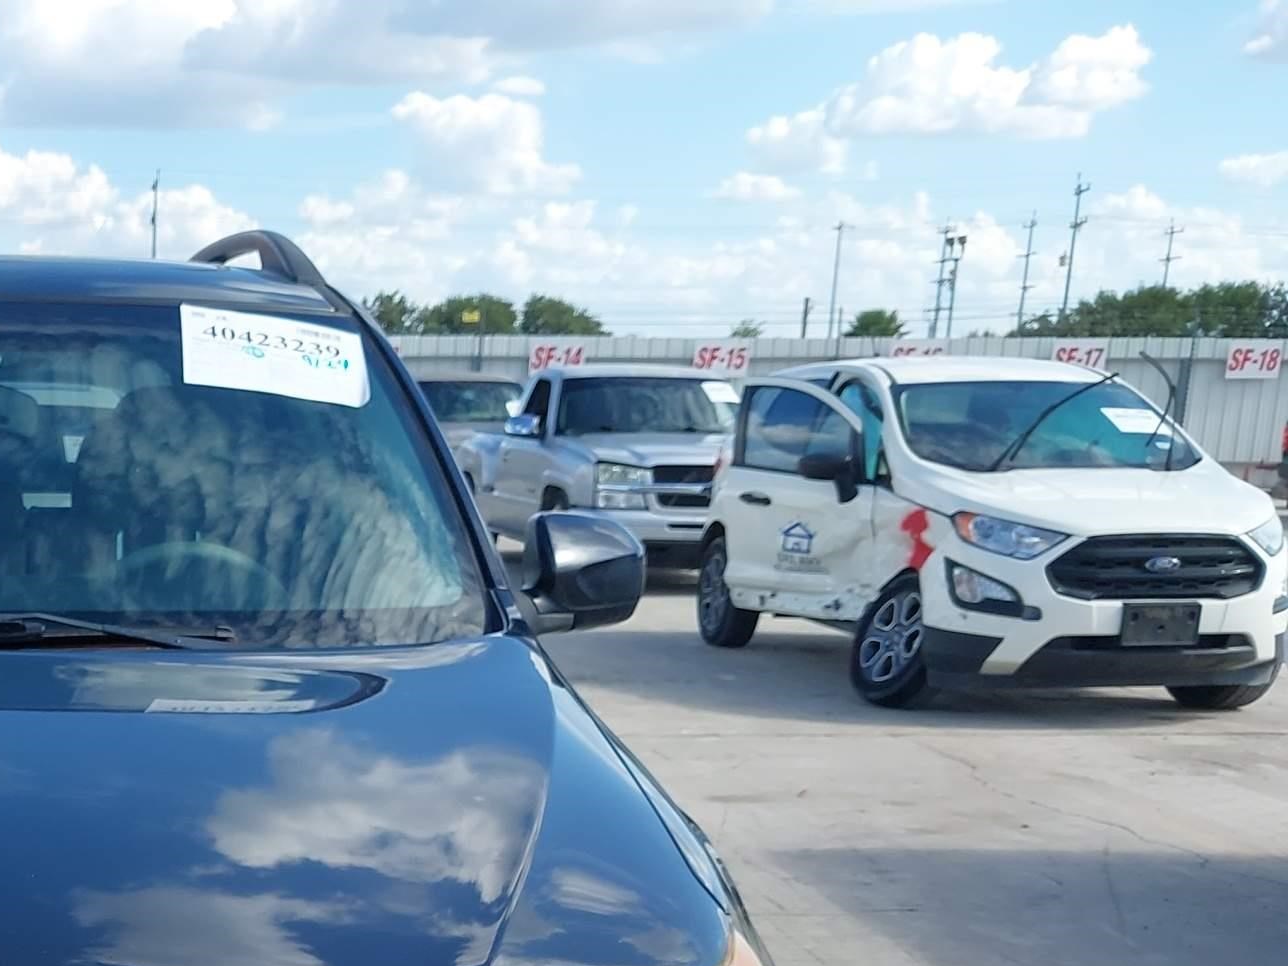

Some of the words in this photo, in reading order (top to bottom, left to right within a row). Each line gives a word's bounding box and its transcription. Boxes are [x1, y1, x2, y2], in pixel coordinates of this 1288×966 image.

[202, 325, 341, 358] 40423239
[694, 346, 747, 370] SF-15
[1228, 347, 1281, 372] SF-18
